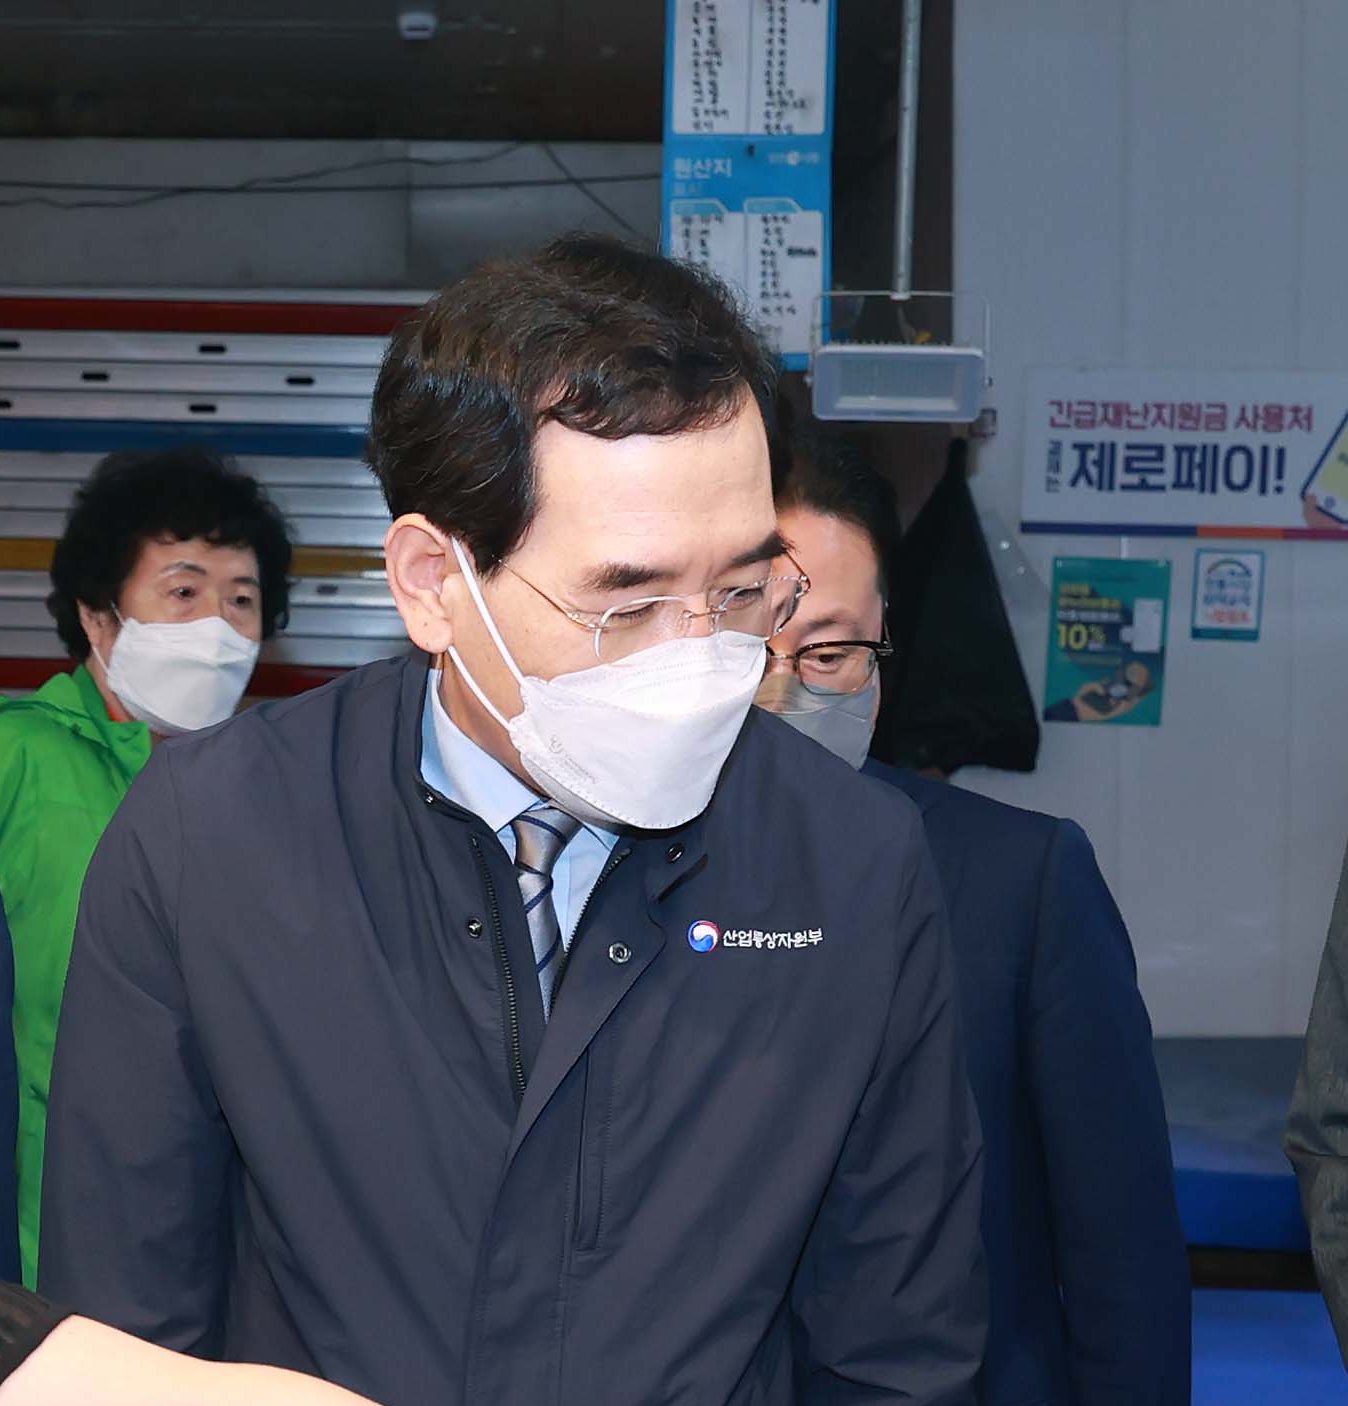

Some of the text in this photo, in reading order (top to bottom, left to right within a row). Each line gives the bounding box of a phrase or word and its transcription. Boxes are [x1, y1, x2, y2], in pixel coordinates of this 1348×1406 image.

[1048, 400, 1314, 433] 긴급재난지원금 사용처
[1070, 441, 1287, 496] 제로페이!
[723, 928, 823, 949] 산업통상자원부
